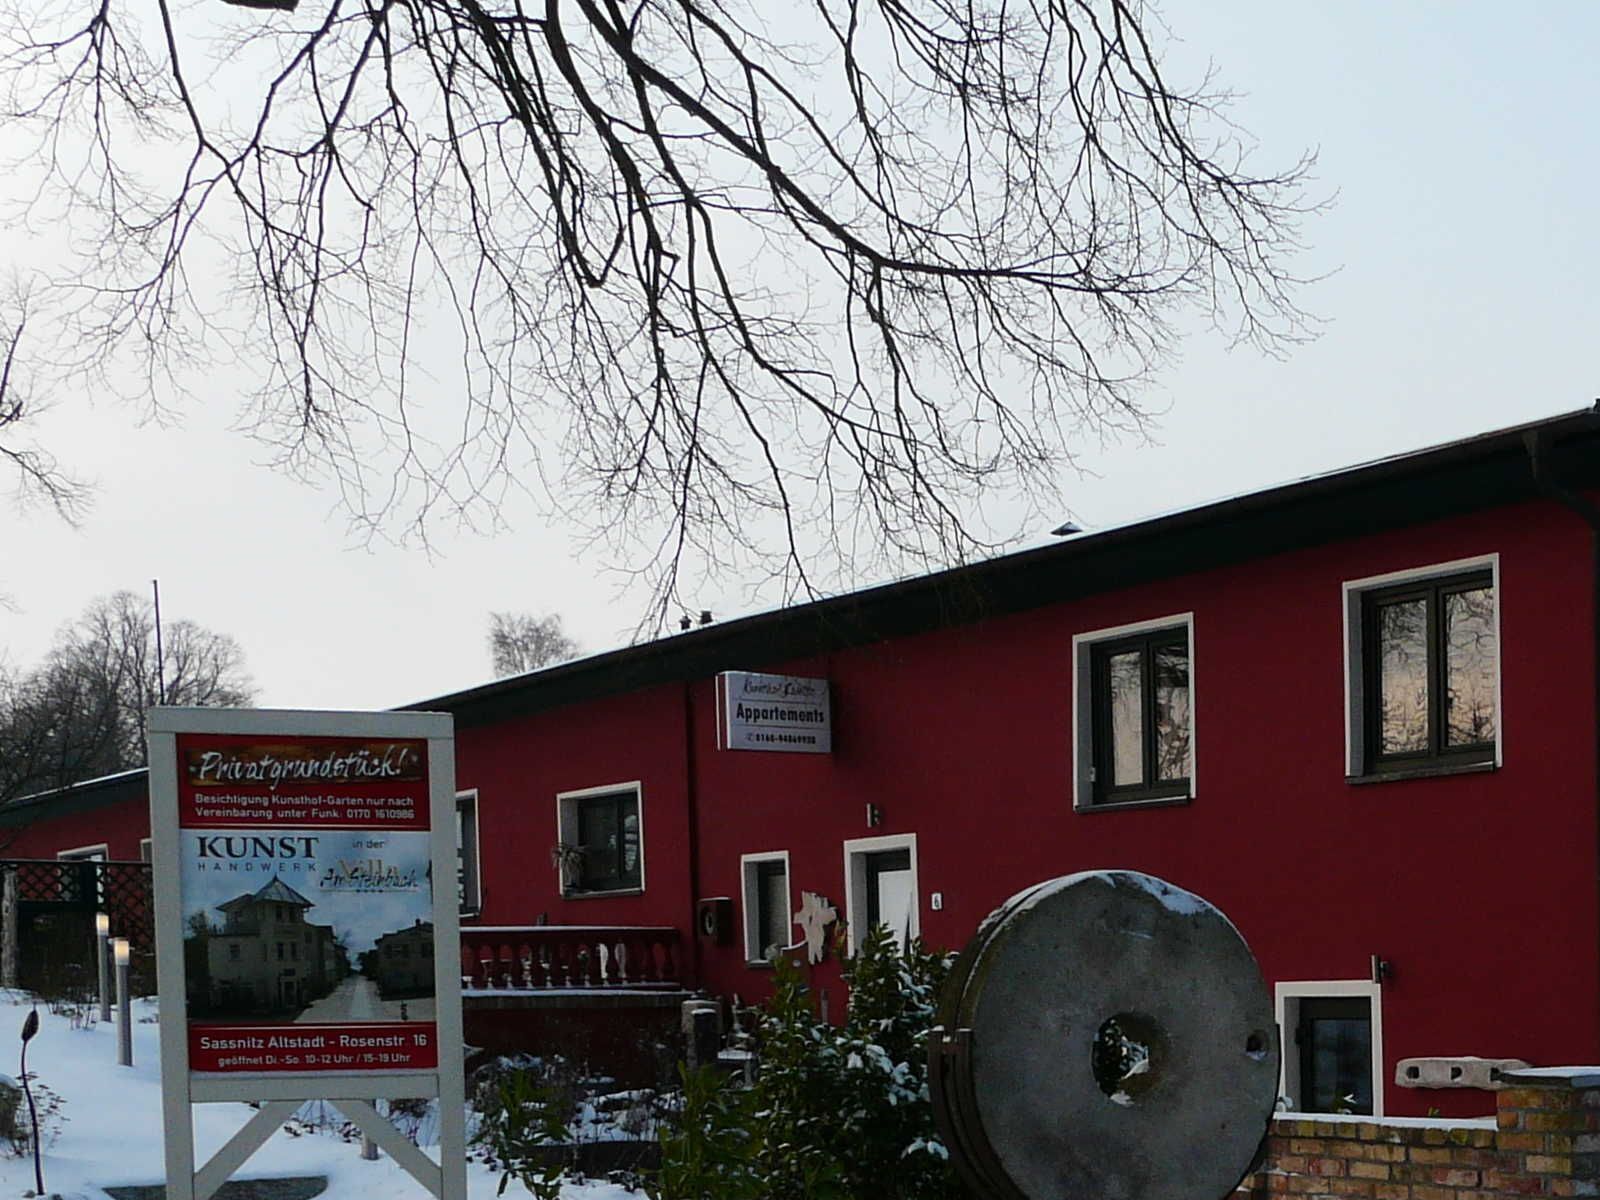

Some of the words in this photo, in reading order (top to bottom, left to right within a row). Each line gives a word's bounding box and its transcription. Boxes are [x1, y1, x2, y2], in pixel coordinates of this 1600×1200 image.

[736, 702, 825, 723] Appartements
[200, 744, 409, 790] Privatgrundstück!
[195, 793, 269, 807] Besichtigung
[271, 795, 364, 806] Kunsthof-Garten
[366, 797, 386, 806] nur
[387, 796, 415, 806] nach
[195, 807, 273, 820] Vereinbarung
[277, 808, 307, 818] unter
[346, 808, 371, 819] 0170
[196, 836, 320, 858] KUNST
[352, 840, 364, 849] in
[365, 839, 385, 849] der
[198, 862, 317, 873] HANDWERK
[200, 1036, 265, 1050] Sassnitz
[267, 1035, 325, 1048] Altstadt
[412, 1034, 428, 1047] 16
[218, 1055, 263, 1068] geöffnet
[305, 1053, 332, 1065] 10-12
[334, 1053, 354, 1064] Uhr
[391, 1052, 411, 1063] Uhr
